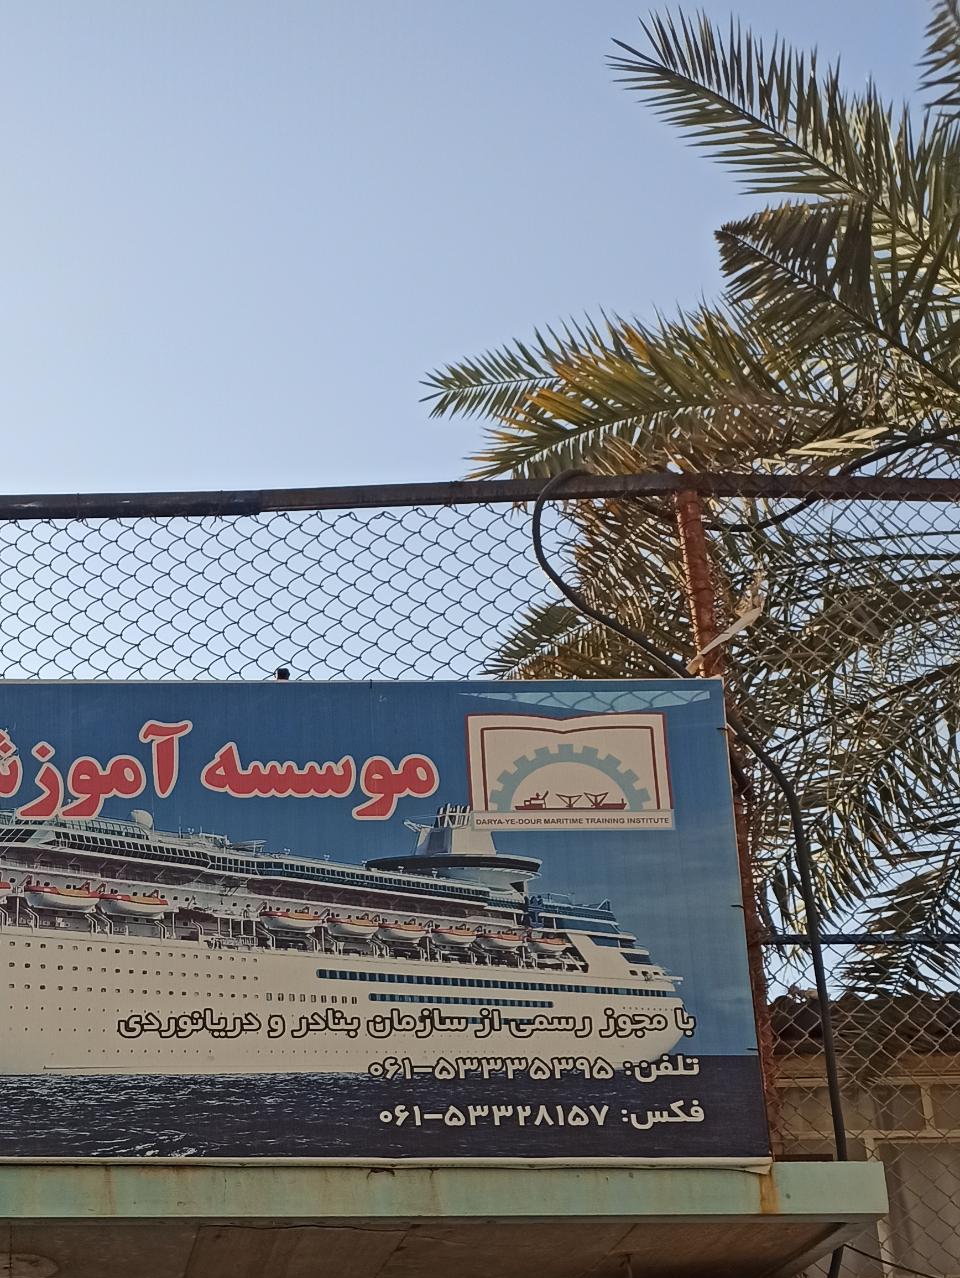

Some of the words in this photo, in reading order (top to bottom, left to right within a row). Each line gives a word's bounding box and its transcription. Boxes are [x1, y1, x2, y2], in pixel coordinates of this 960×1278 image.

[201, 741, 440, 822] موسسه
[476, 817, 542, 826] DARYA-YE-DOUR
[544, 817, 584, 825] MARITIME
[585, 816, 625, 825] TRAINING
[627, 816, 670, 825] INSTITUTE
[117, 1008, 262, 1038] دریانوردی
[267, 1014, 286, 1038] و
[291, 1008, 361, 1038] بنادر
[367, 1009, 468, 1038] سازمان
[475, 1009, 501, 1038] از
[508, 1014, 592, 1038] رسمی
[599, 1008, 668, 1038] مجوز
[674, 1008, 696, 1037] با
[624, 1053, 700, 1083] تلفن:
[621, 1100, 705, 1130] فکس:
